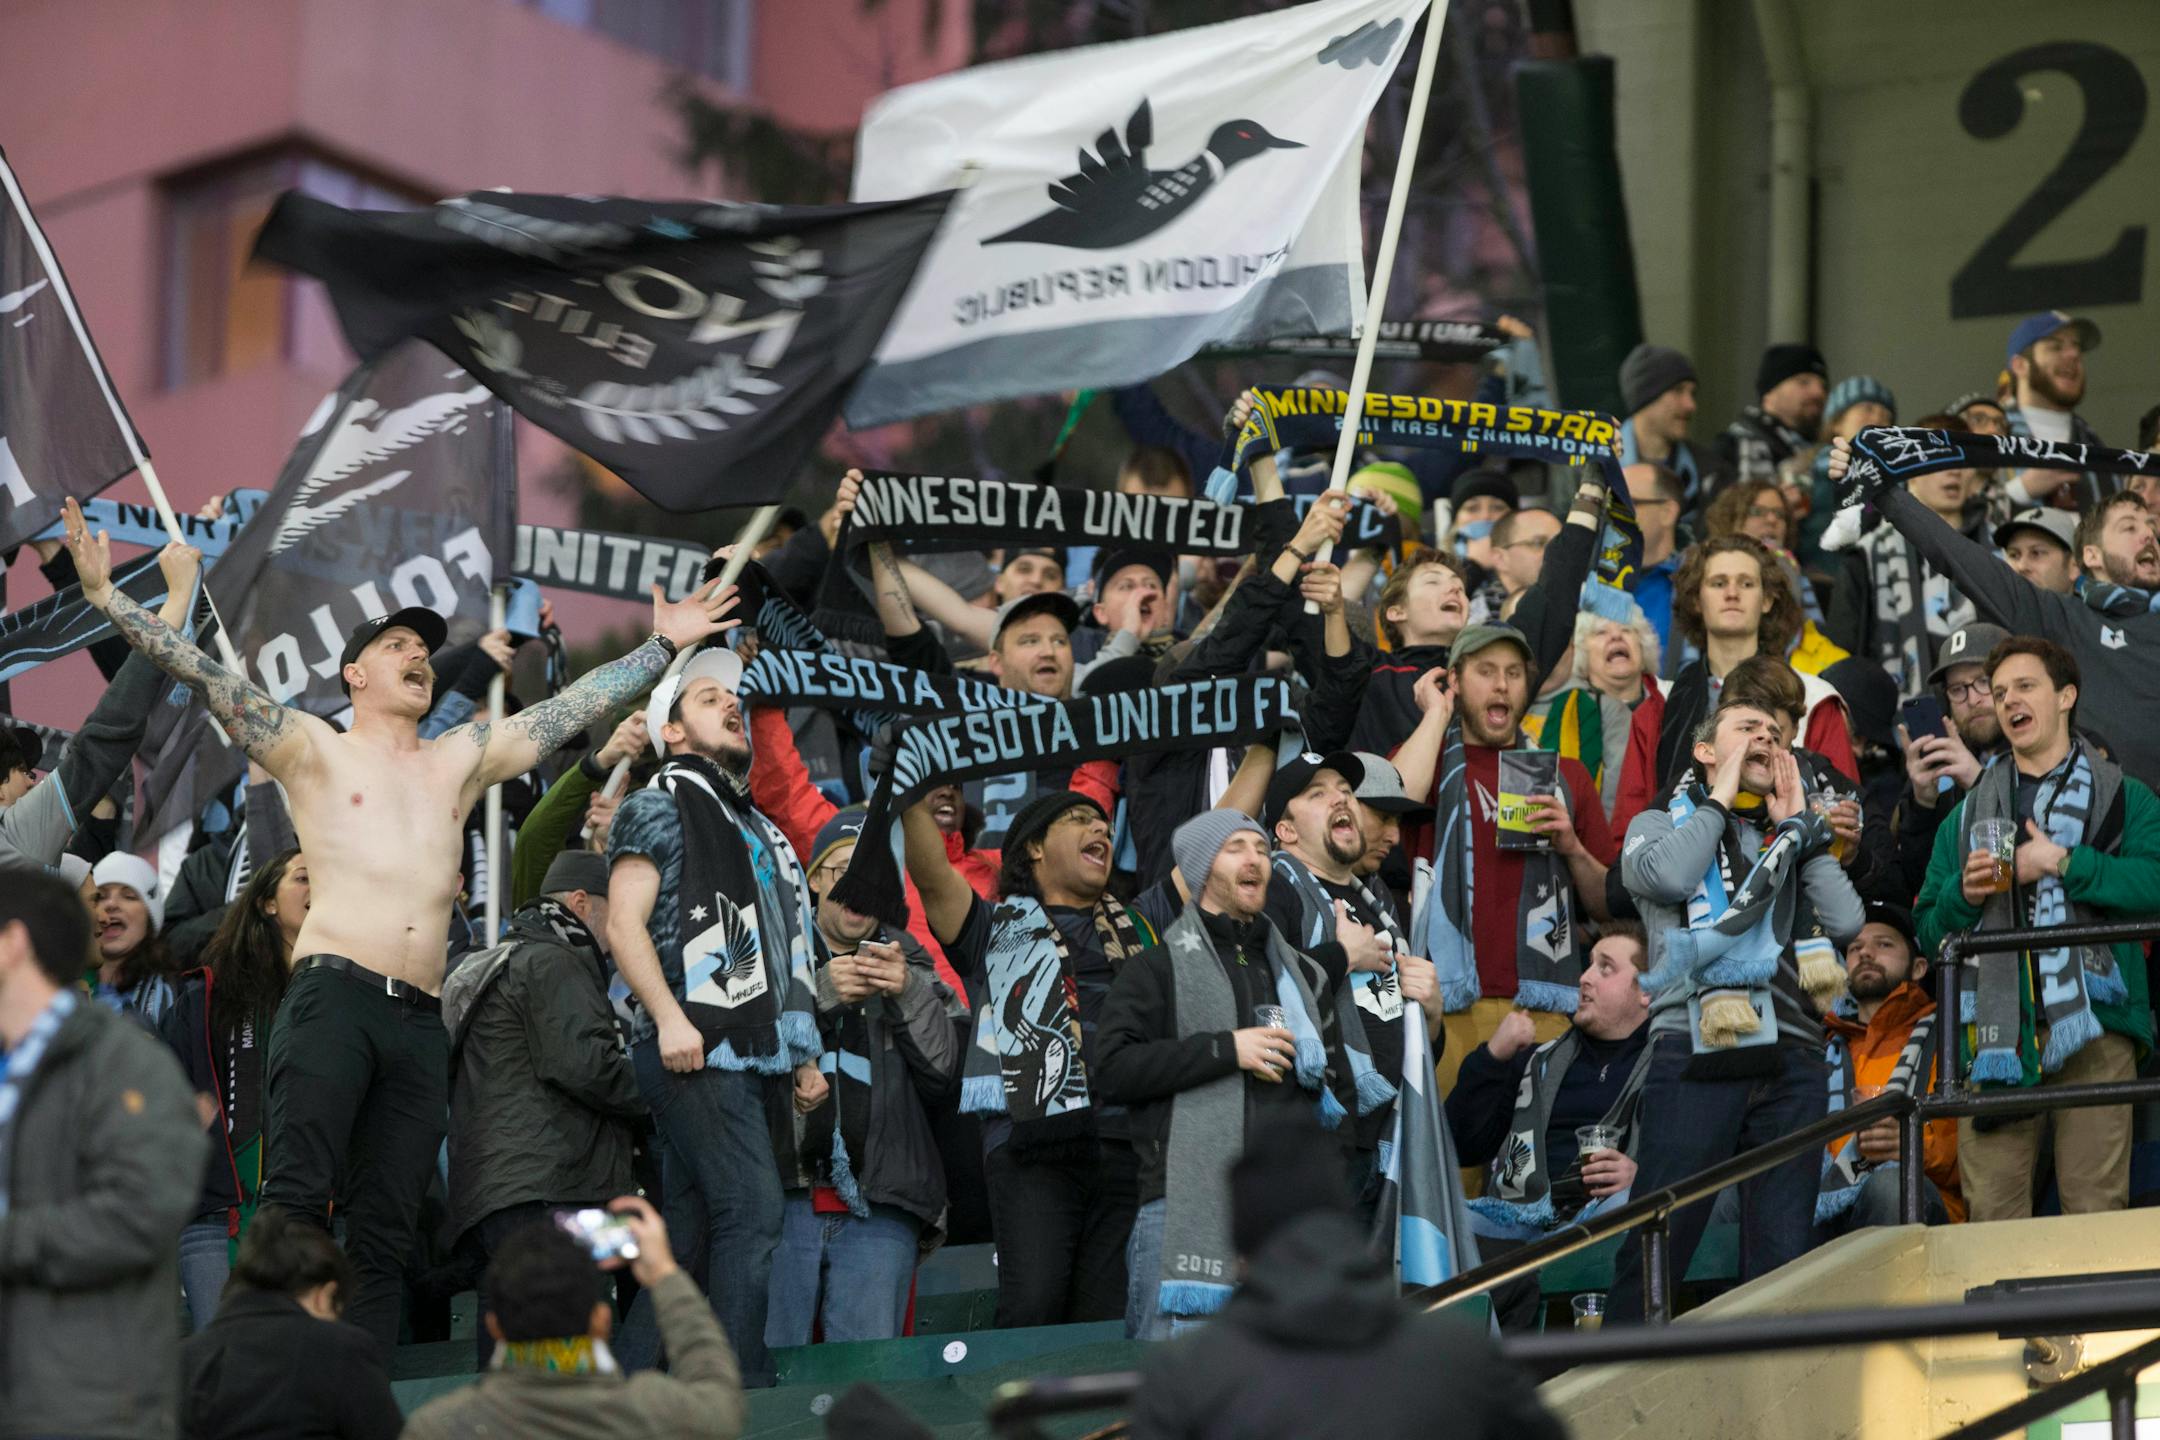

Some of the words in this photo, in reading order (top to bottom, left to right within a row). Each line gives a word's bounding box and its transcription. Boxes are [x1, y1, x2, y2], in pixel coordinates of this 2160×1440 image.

[1951, 40, 2149, 321] 2
[1334, 416, 1379, 432] 211
[1392, 421, 1453, 438] NASL
[1467, 428, 1612, 457] CHAMPIONS
[1084, 489, 1245, 550] UNITED
[1950, 629, 1967, 655] D
[1092, 678, 1238, 746] UNITED
[732, 981, 764, 1003] MNUFC
[1176, 1254, 1223, 1277] 2016
